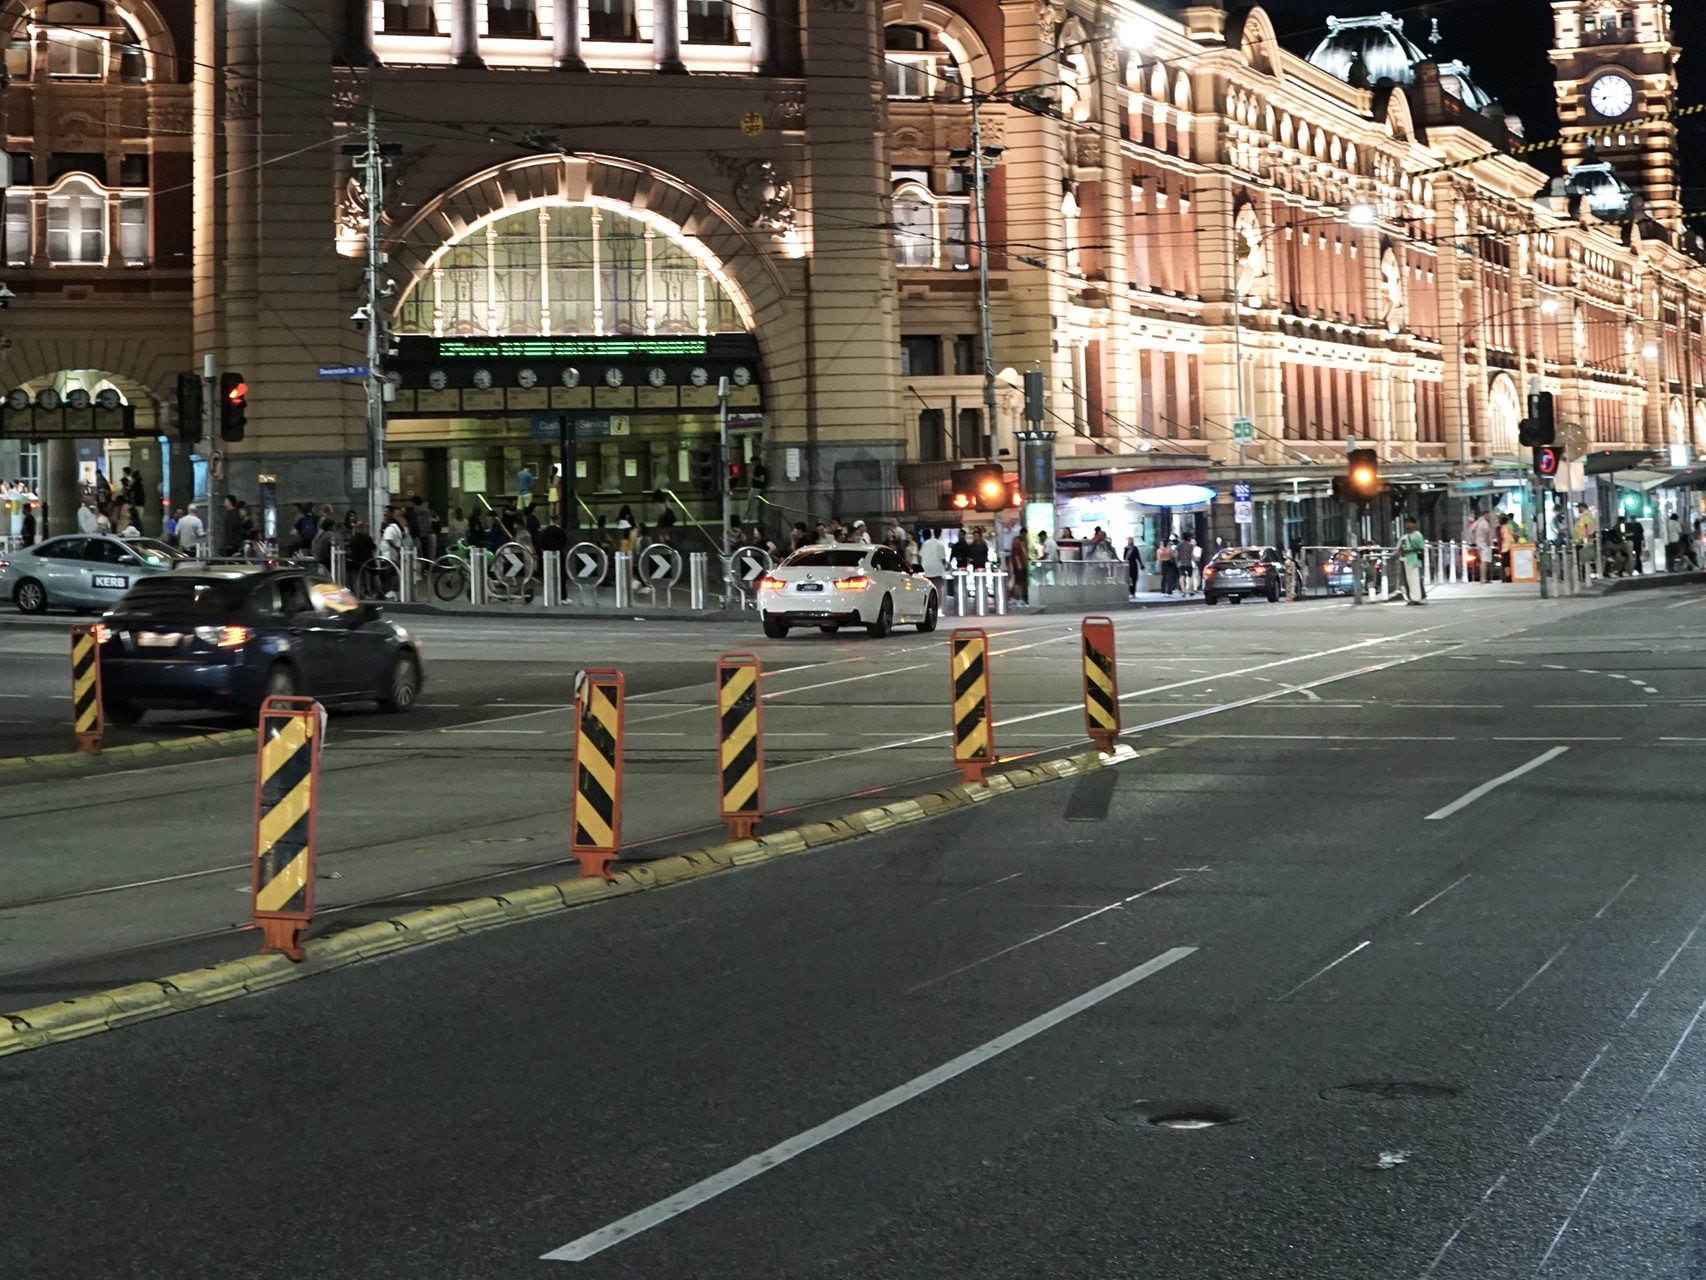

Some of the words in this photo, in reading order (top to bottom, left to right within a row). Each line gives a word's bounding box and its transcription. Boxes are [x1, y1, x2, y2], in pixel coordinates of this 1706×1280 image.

[743, 114, 761, 123] CUT
[744, 125, 761, 134] OFF
[1238, 507, 1249, 516] 40
[95, 576, 125, 587] KERB
